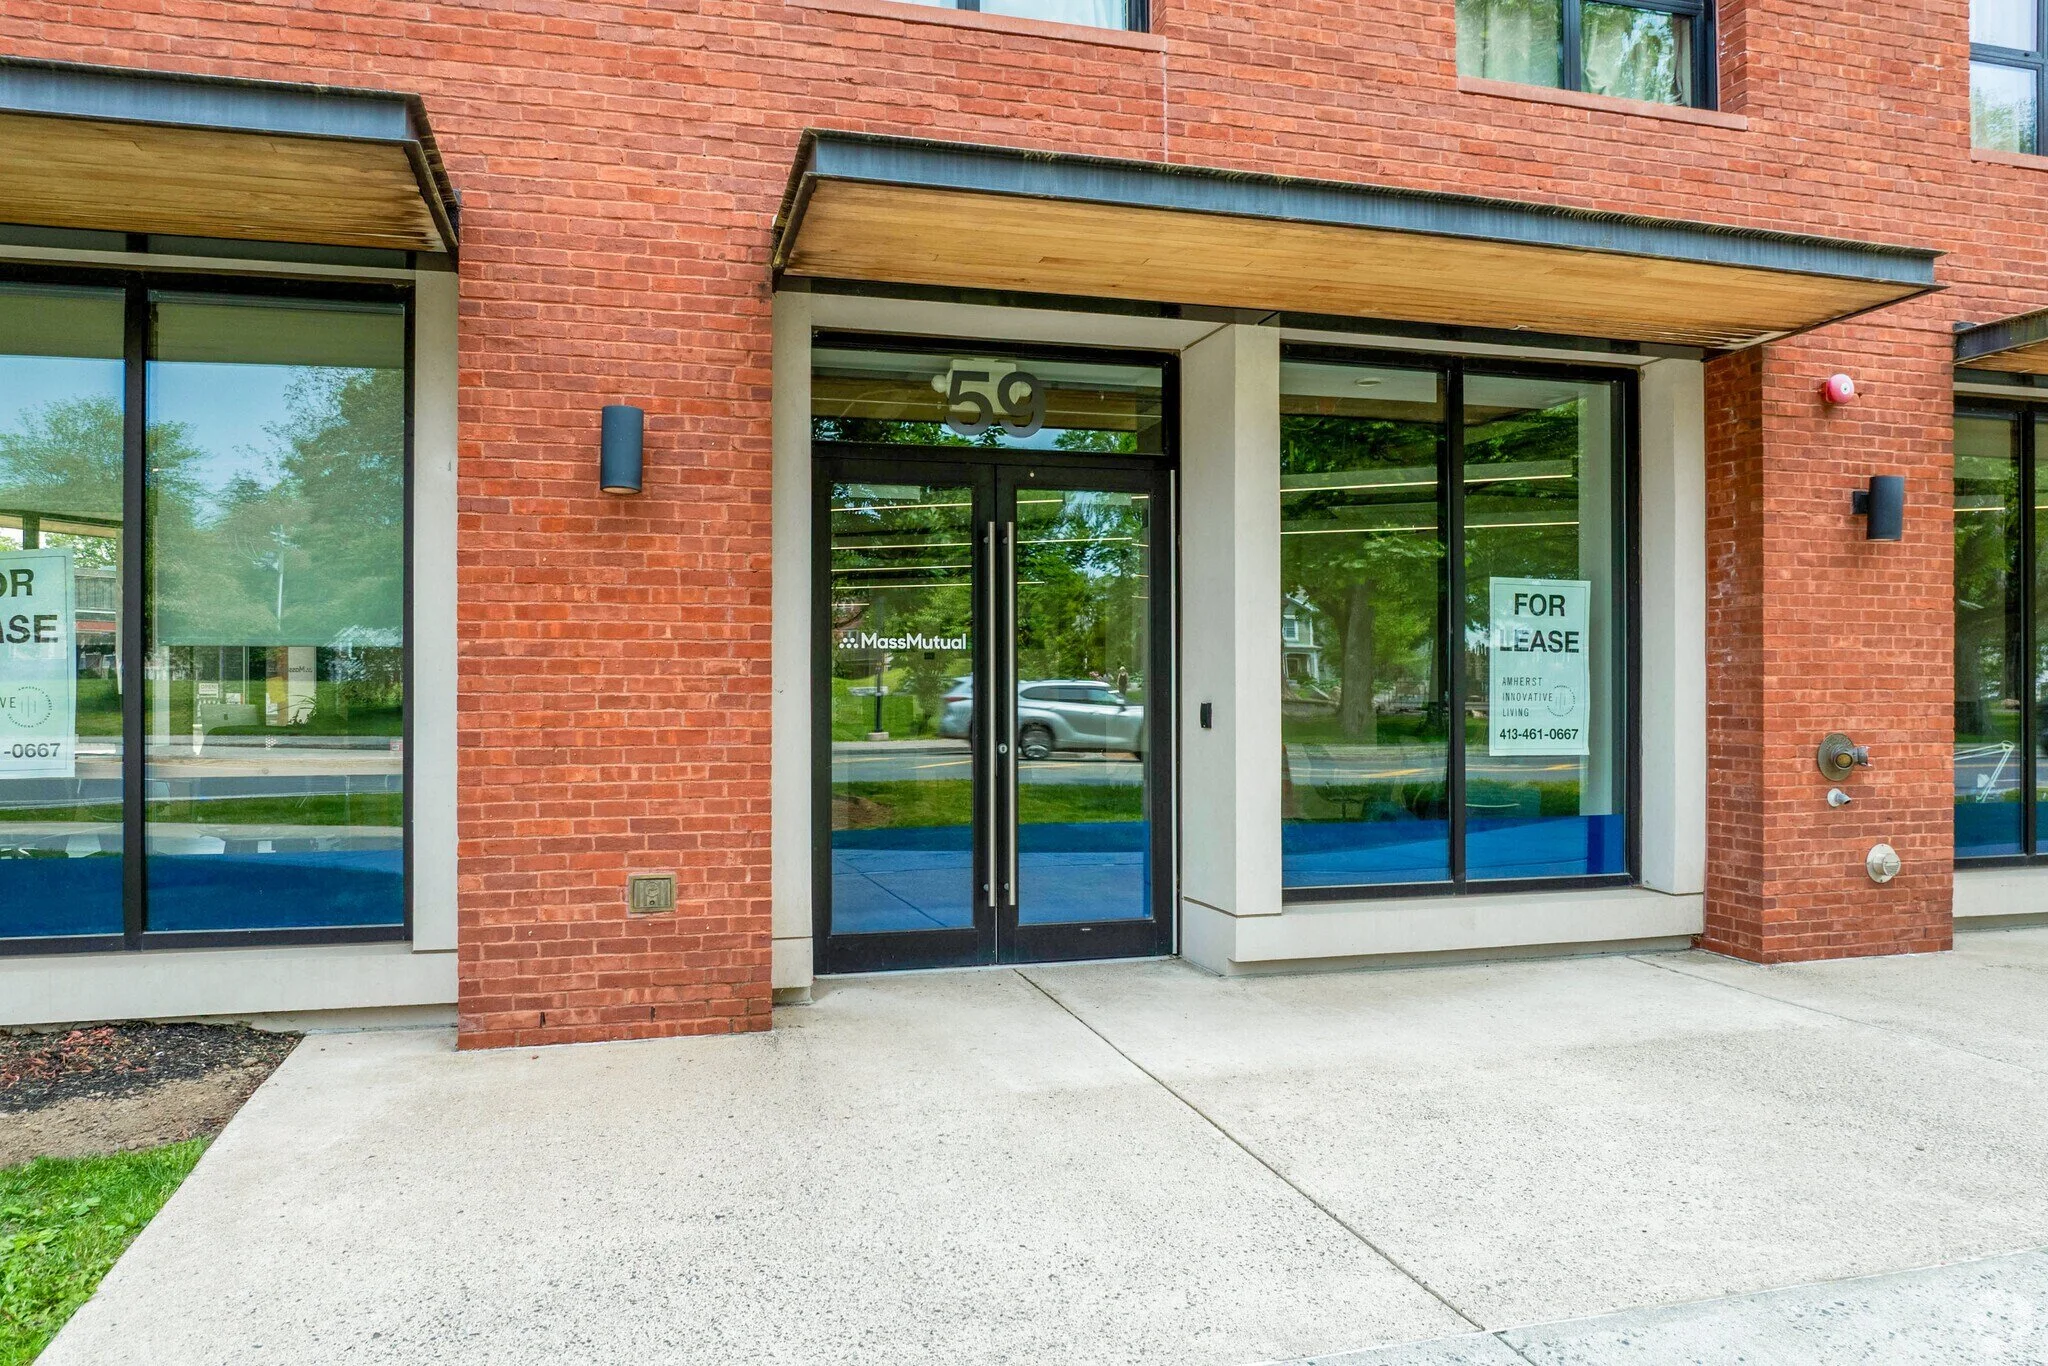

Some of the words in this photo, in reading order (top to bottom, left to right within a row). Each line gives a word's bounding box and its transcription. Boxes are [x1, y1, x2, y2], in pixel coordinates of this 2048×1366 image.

[945, 369, 1046, 438] 59
[0, 569, 34, 597] R
[1514, 593, 1565, 617] FOR
[0, 615, 58, 643] SE
[861, 632, 967, 650] MassMutual
[1499, 629, 1579, 653] LEASE
[1502, 677, 1542, 686] AMHERST
[1502, 692, 1553, 702] INNOVATIVE
[1502, 708, 1529, 717] LIVING
[1500, 728, 1579, 740] 413-461-0667
[4, 742, 61, 758] -0667
